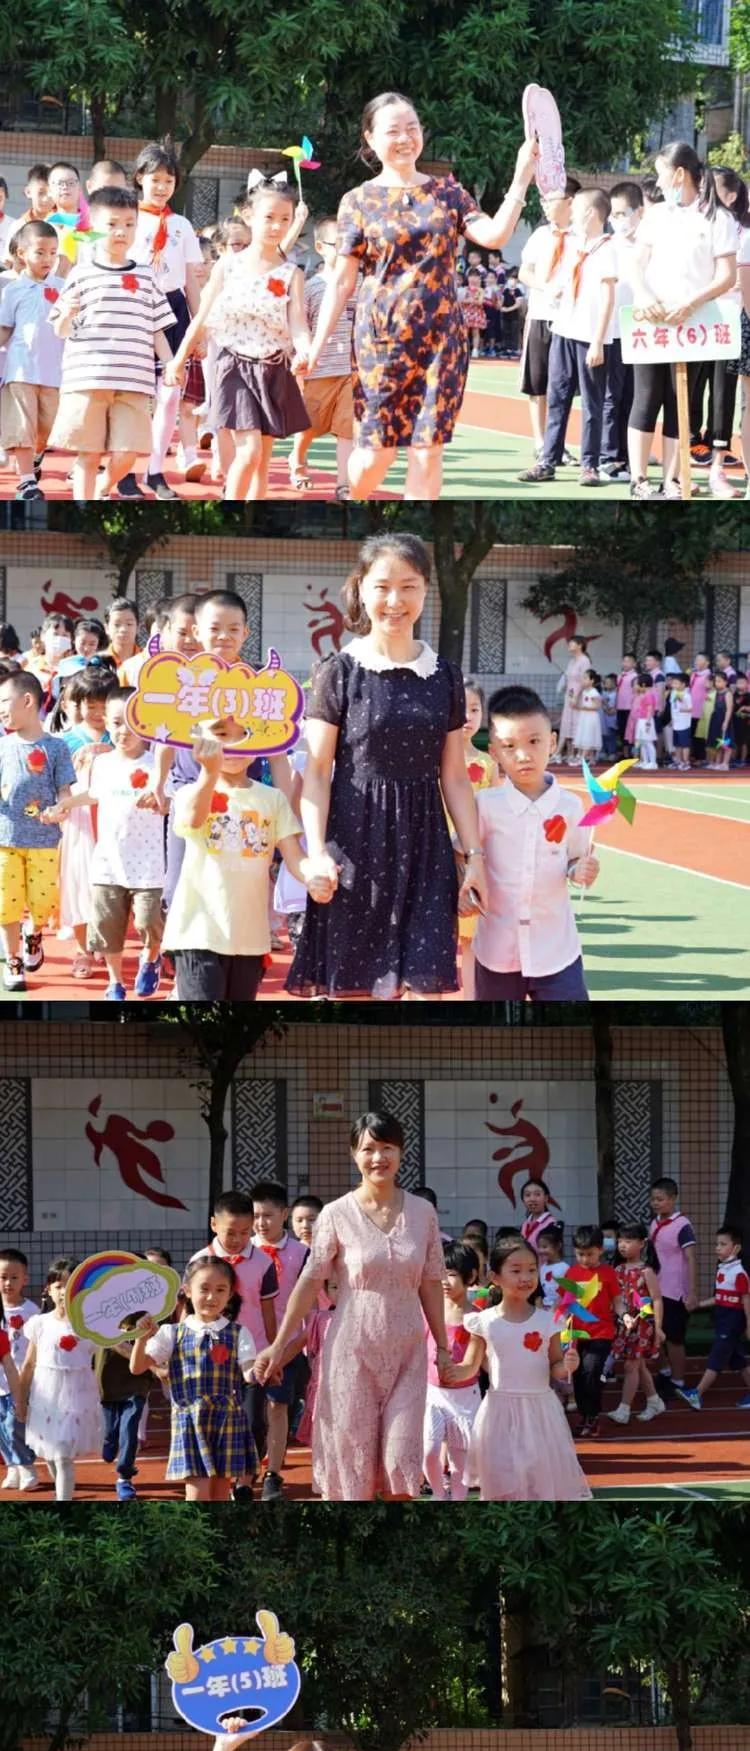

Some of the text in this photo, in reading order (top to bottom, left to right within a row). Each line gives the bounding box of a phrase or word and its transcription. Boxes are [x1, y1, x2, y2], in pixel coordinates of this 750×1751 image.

[632, 322, 731, 348] 六年(6)班
[181, 1664, 288, 1698] 一年(5)班
